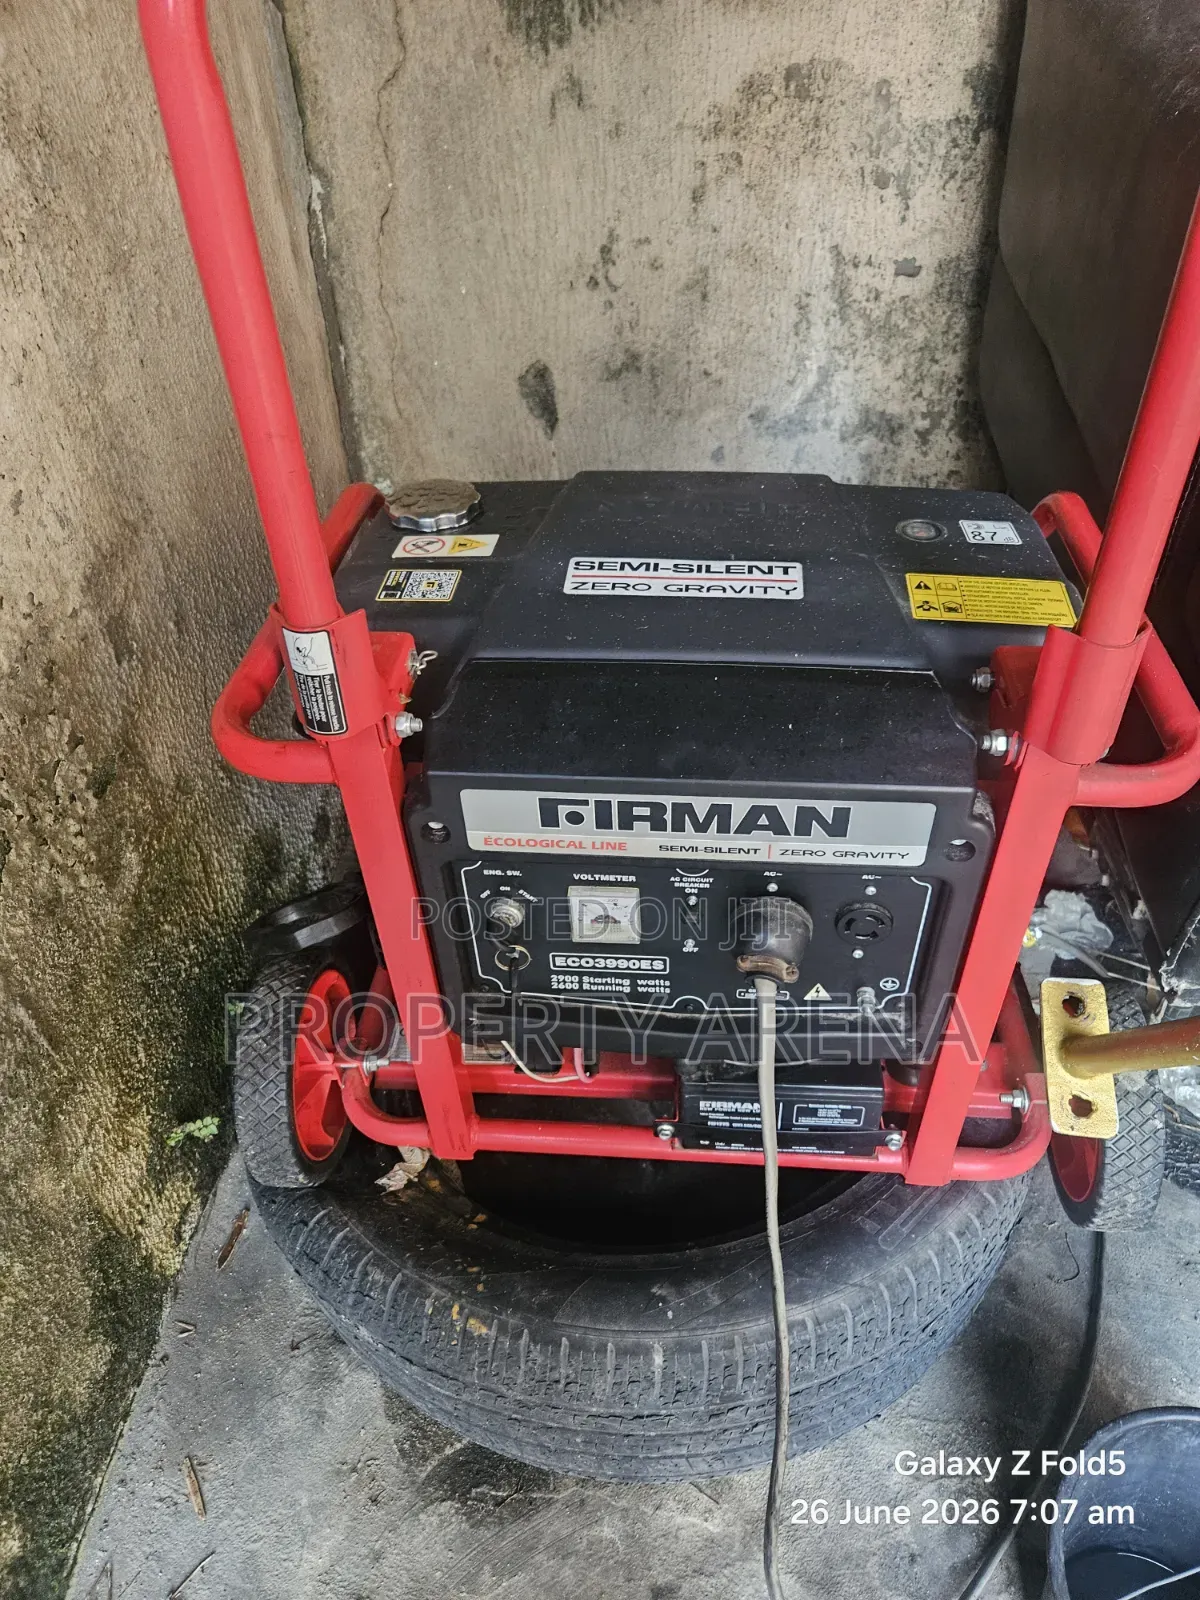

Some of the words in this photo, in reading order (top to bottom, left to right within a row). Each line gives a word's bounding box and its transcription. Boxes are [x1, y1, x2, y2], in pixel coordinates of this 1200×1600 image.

[971, 530, 997, 541] 87
[573, 560, 797, 576] SEMI-SILENT
[571, 581, 652, 592] ZERO
[663, 583, 798, 596] GRAVITY
[537, 796, 851, 838] FIRMAN
[591, 841, 627, 851] LINE
[658, 844, 762, 856] SEMI-SILENT
[779, 849, 826, 857] ZERO
[832, 850, 910, 860] GRAVITY
[573, 873, 636, 882] VOLTMETER
[518, 889, 538, 903] START
[554, 956, 665, 970] ECO3990ES
[550, 975, 579, 983] 2900
[582, 976, 630, 986] Starting
[551, 982, 579, 990] 2600
[582, 983, 630, 993] Running
